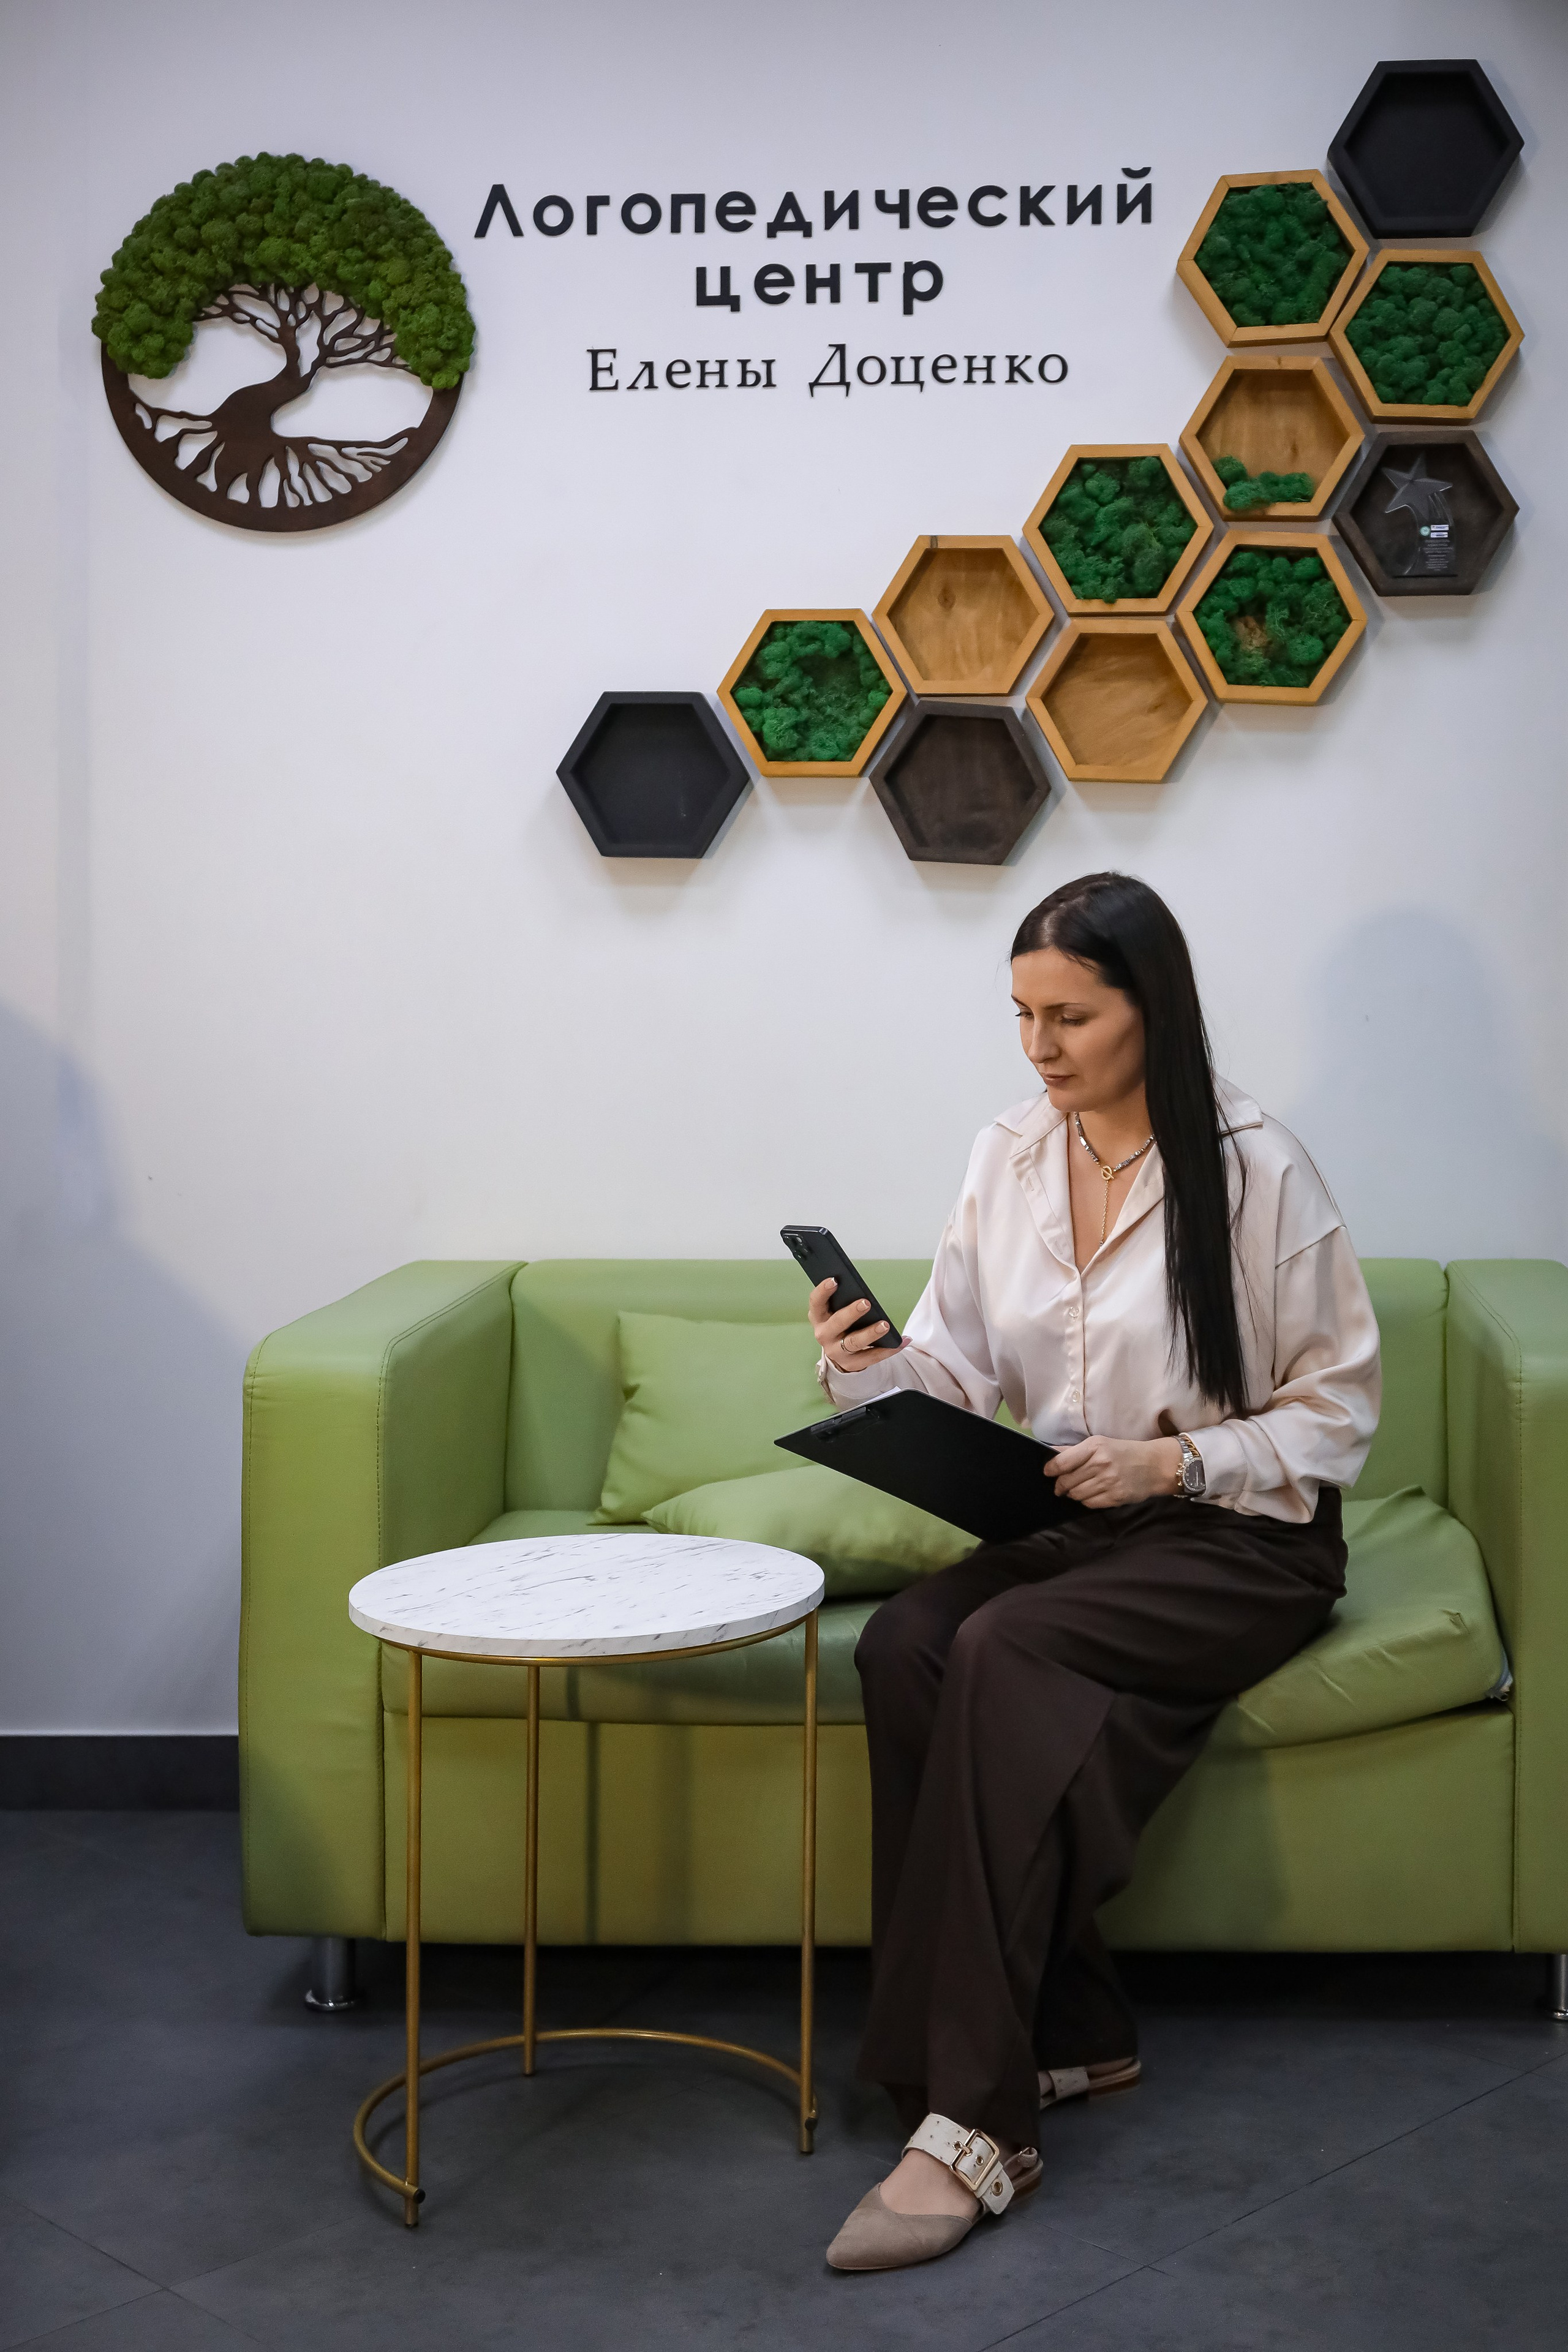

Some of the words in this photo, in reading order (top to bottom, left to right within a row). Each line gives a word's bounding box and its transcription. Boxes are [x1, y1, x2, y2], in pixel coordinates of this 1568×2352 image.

[473, 167, 1152, 239] Логопедический
[696, 260, 944, 315] центр
[586, 348, 777, 391] Елены
[808, 343, 1068, 398] Доценко
